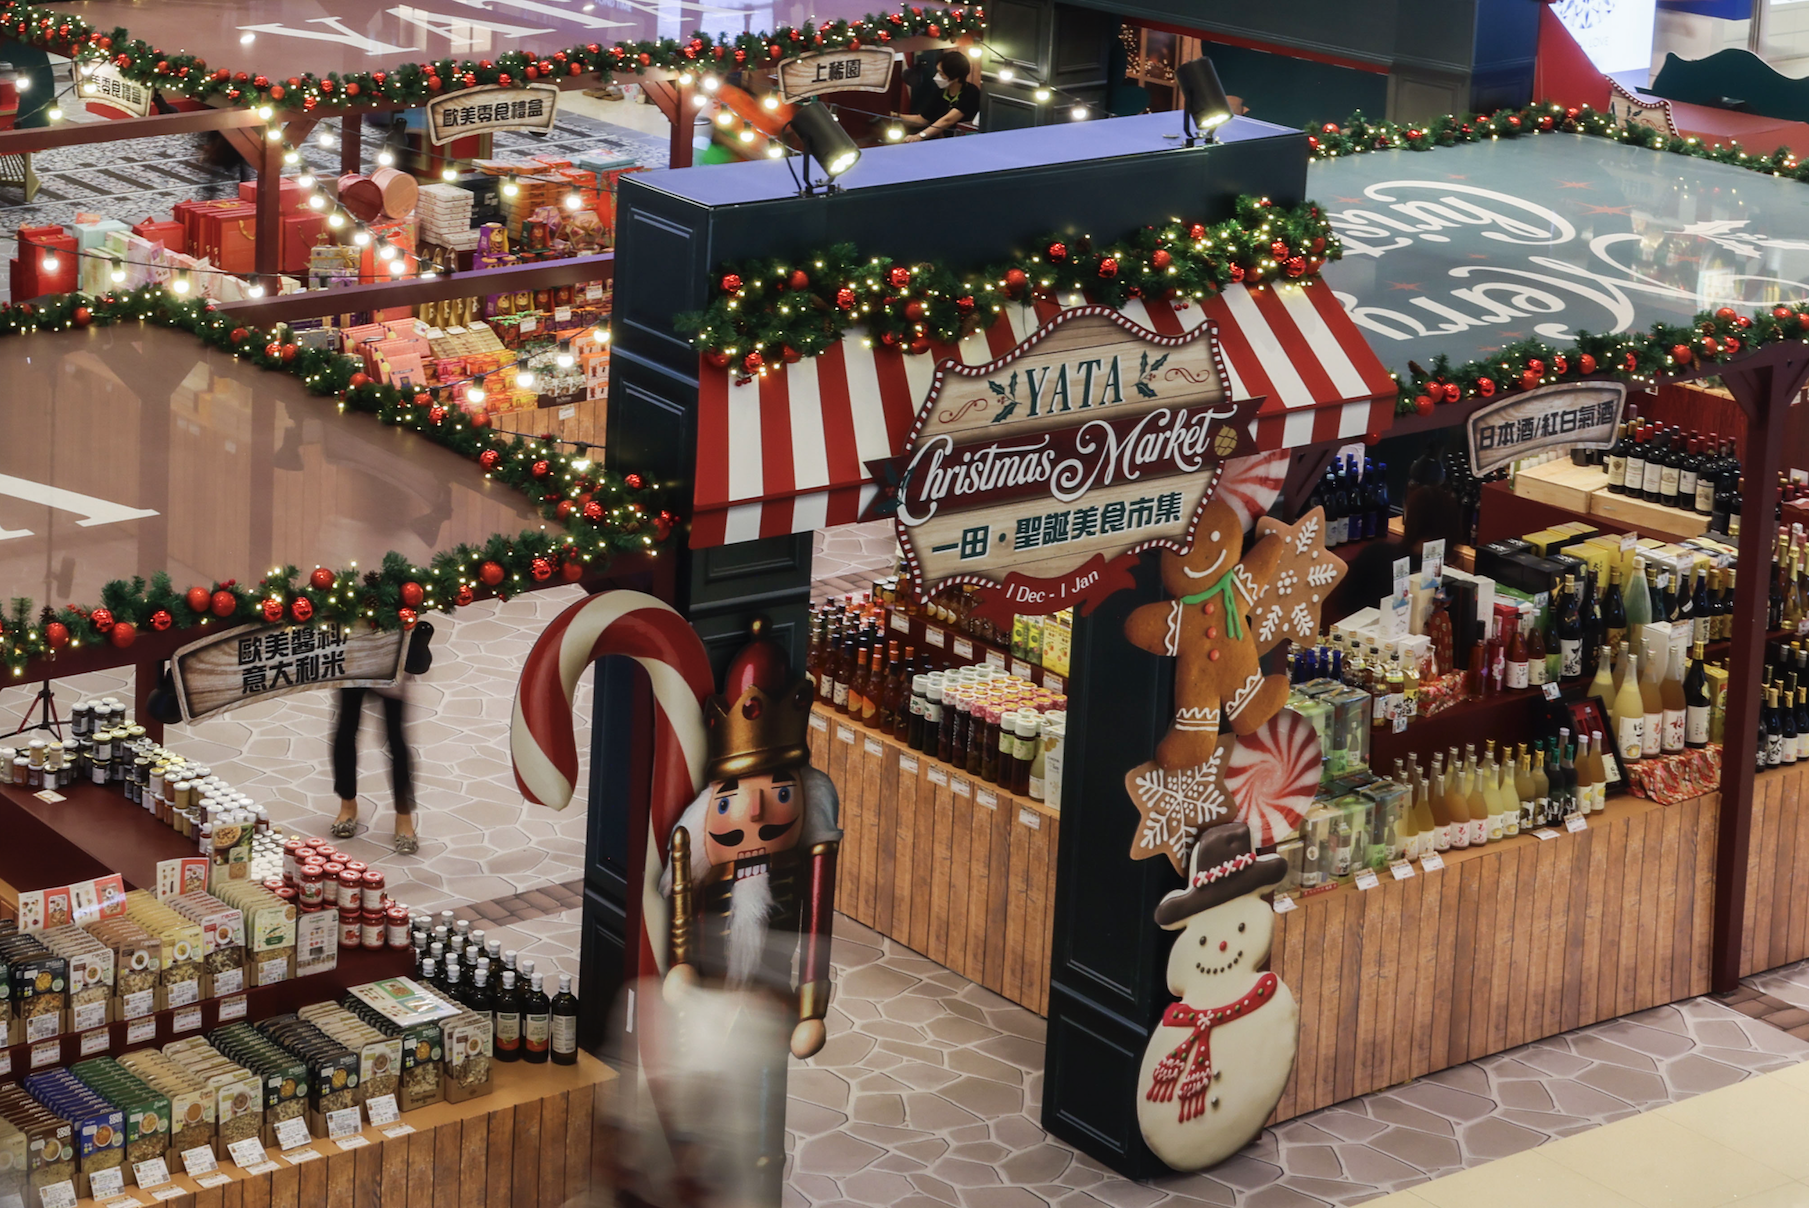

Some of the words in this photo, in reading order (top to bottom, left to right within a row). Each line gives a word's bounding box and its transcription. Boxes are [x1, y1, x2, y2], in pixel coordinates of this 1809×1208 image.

[443, 97, 545, 128] 歐美零食禮盒
[1025, 355, 1124, 418] YATA
[1478, 399, 1616, 450] 日本酒/紅白氣酒
[897, 433, 1057, 527] Christmas
[1051, 403, 1239, 503] Market
[1015, 585, 1046, 603] Dec
[1071, 568, 1100, 594] Jan
[241, 650, 346, 695] 意大利米
